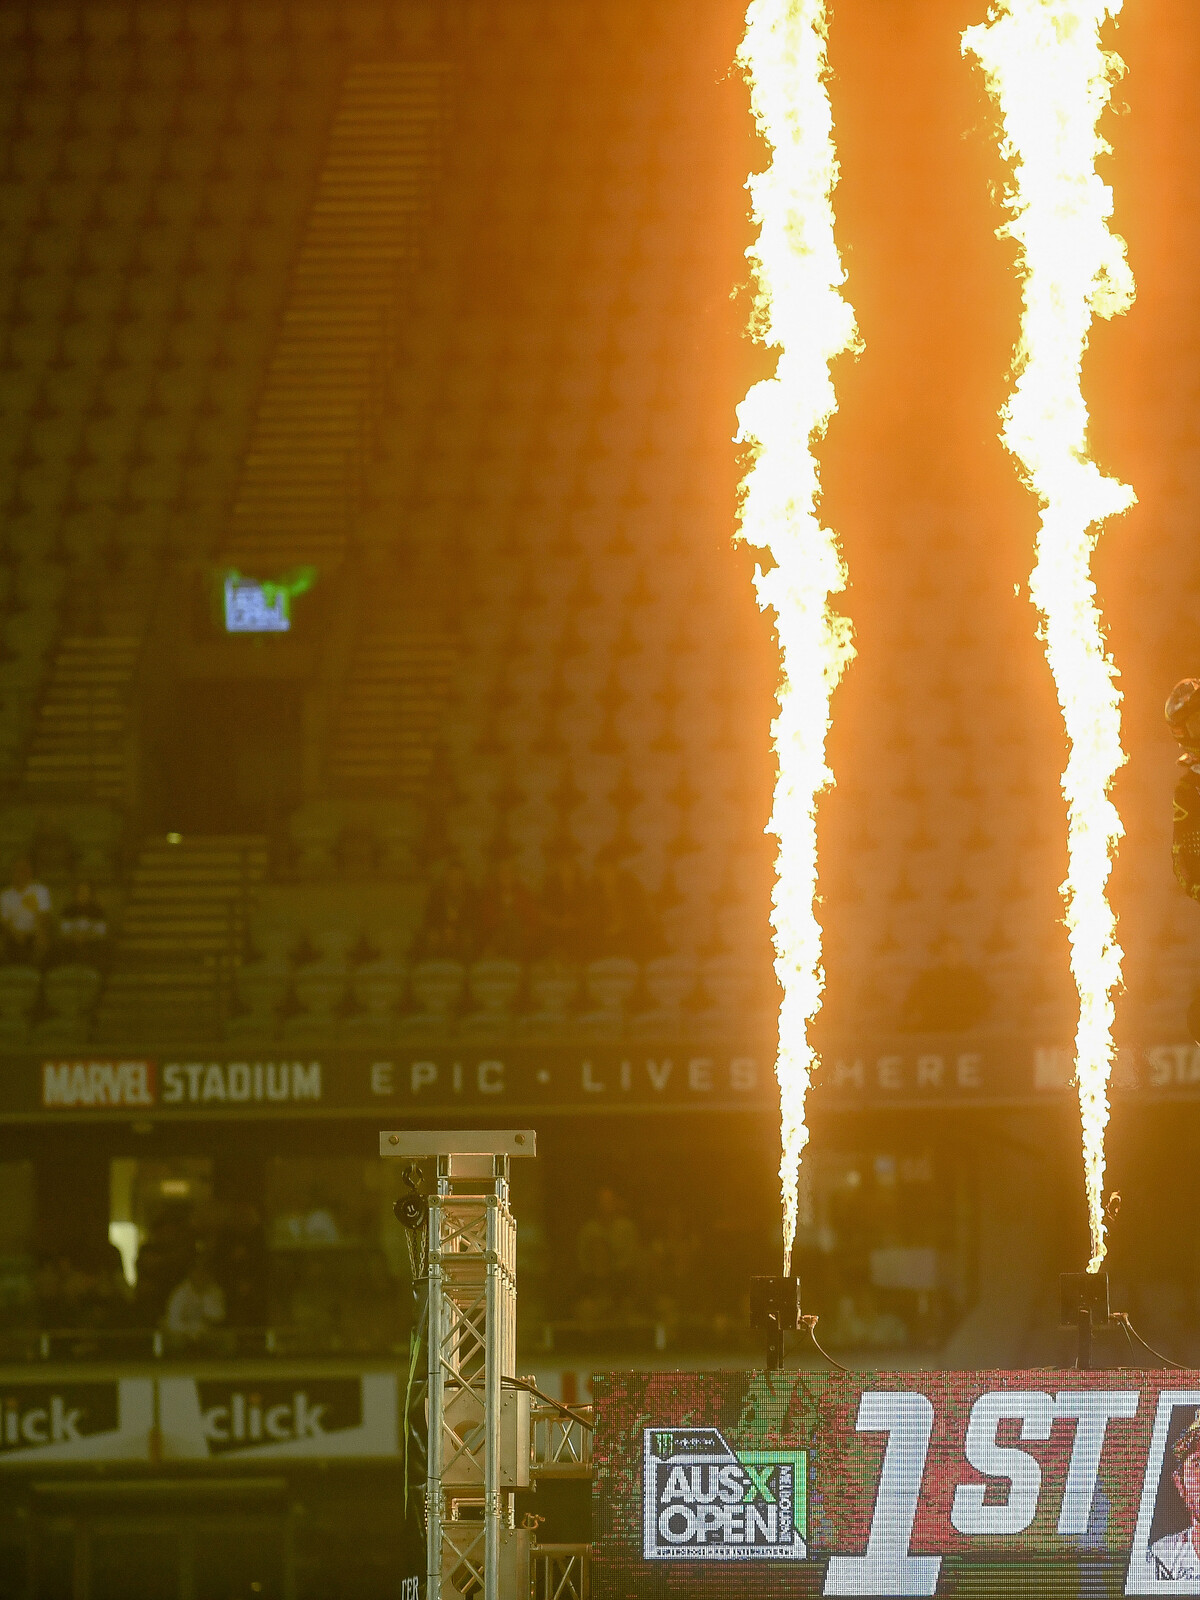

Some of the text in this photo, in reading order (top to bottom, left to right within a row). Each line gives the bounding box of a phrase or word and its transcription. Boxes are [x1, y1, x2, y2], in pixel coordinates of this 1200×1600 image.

[44, 1062, 322, 1104] MARVEL STADIUM
[371, 1053, 982, 1095] EPIC LIVES HERE
[205, 1392, 326, 1440] click
[660, 1465, 777, 1503] AUS-X
[658, 1504, 778, 1543] OPEN
